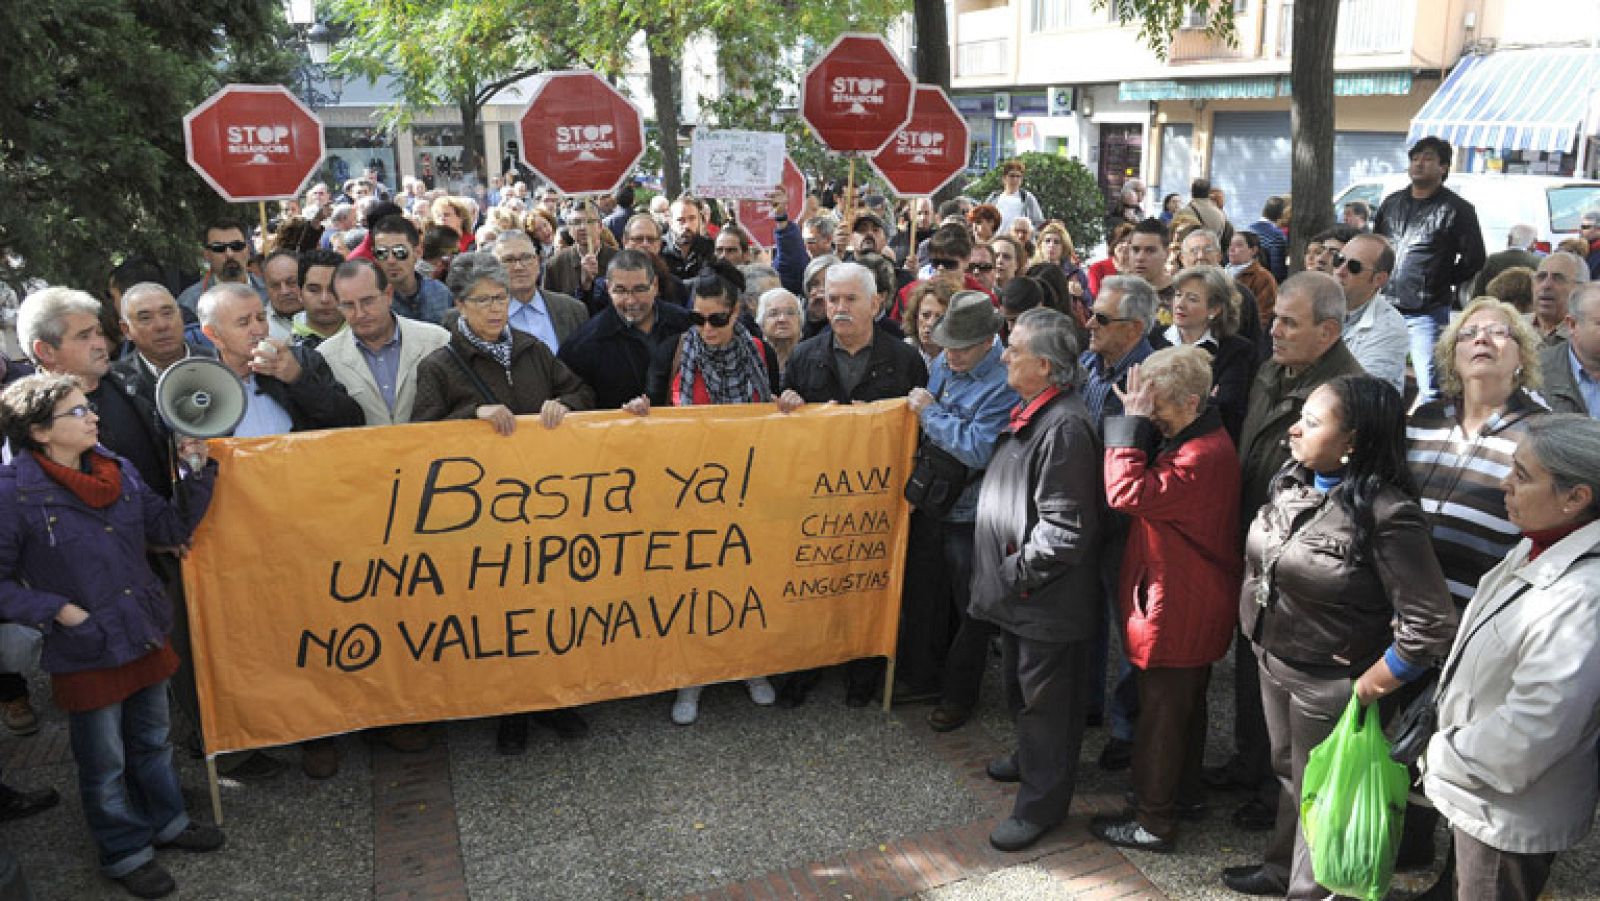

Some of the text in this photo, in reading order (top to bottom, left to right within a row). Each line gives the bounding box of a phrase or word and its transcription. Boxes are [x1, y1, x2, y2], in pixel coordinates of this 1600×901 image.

[832, 77, 886, 96] STOP
[227, 126, 289, 143] STOP
[556, 124, 614, 143] STOP
[897, 130, 944, 147] STOP
[801, 510, 890, 537] CHANA
[329, 552, 445, 603] UNA
[782, 570, 890, 598] ANGUSTIAS
[296, 585, 768, 672] NO VALE UNA VIDA
